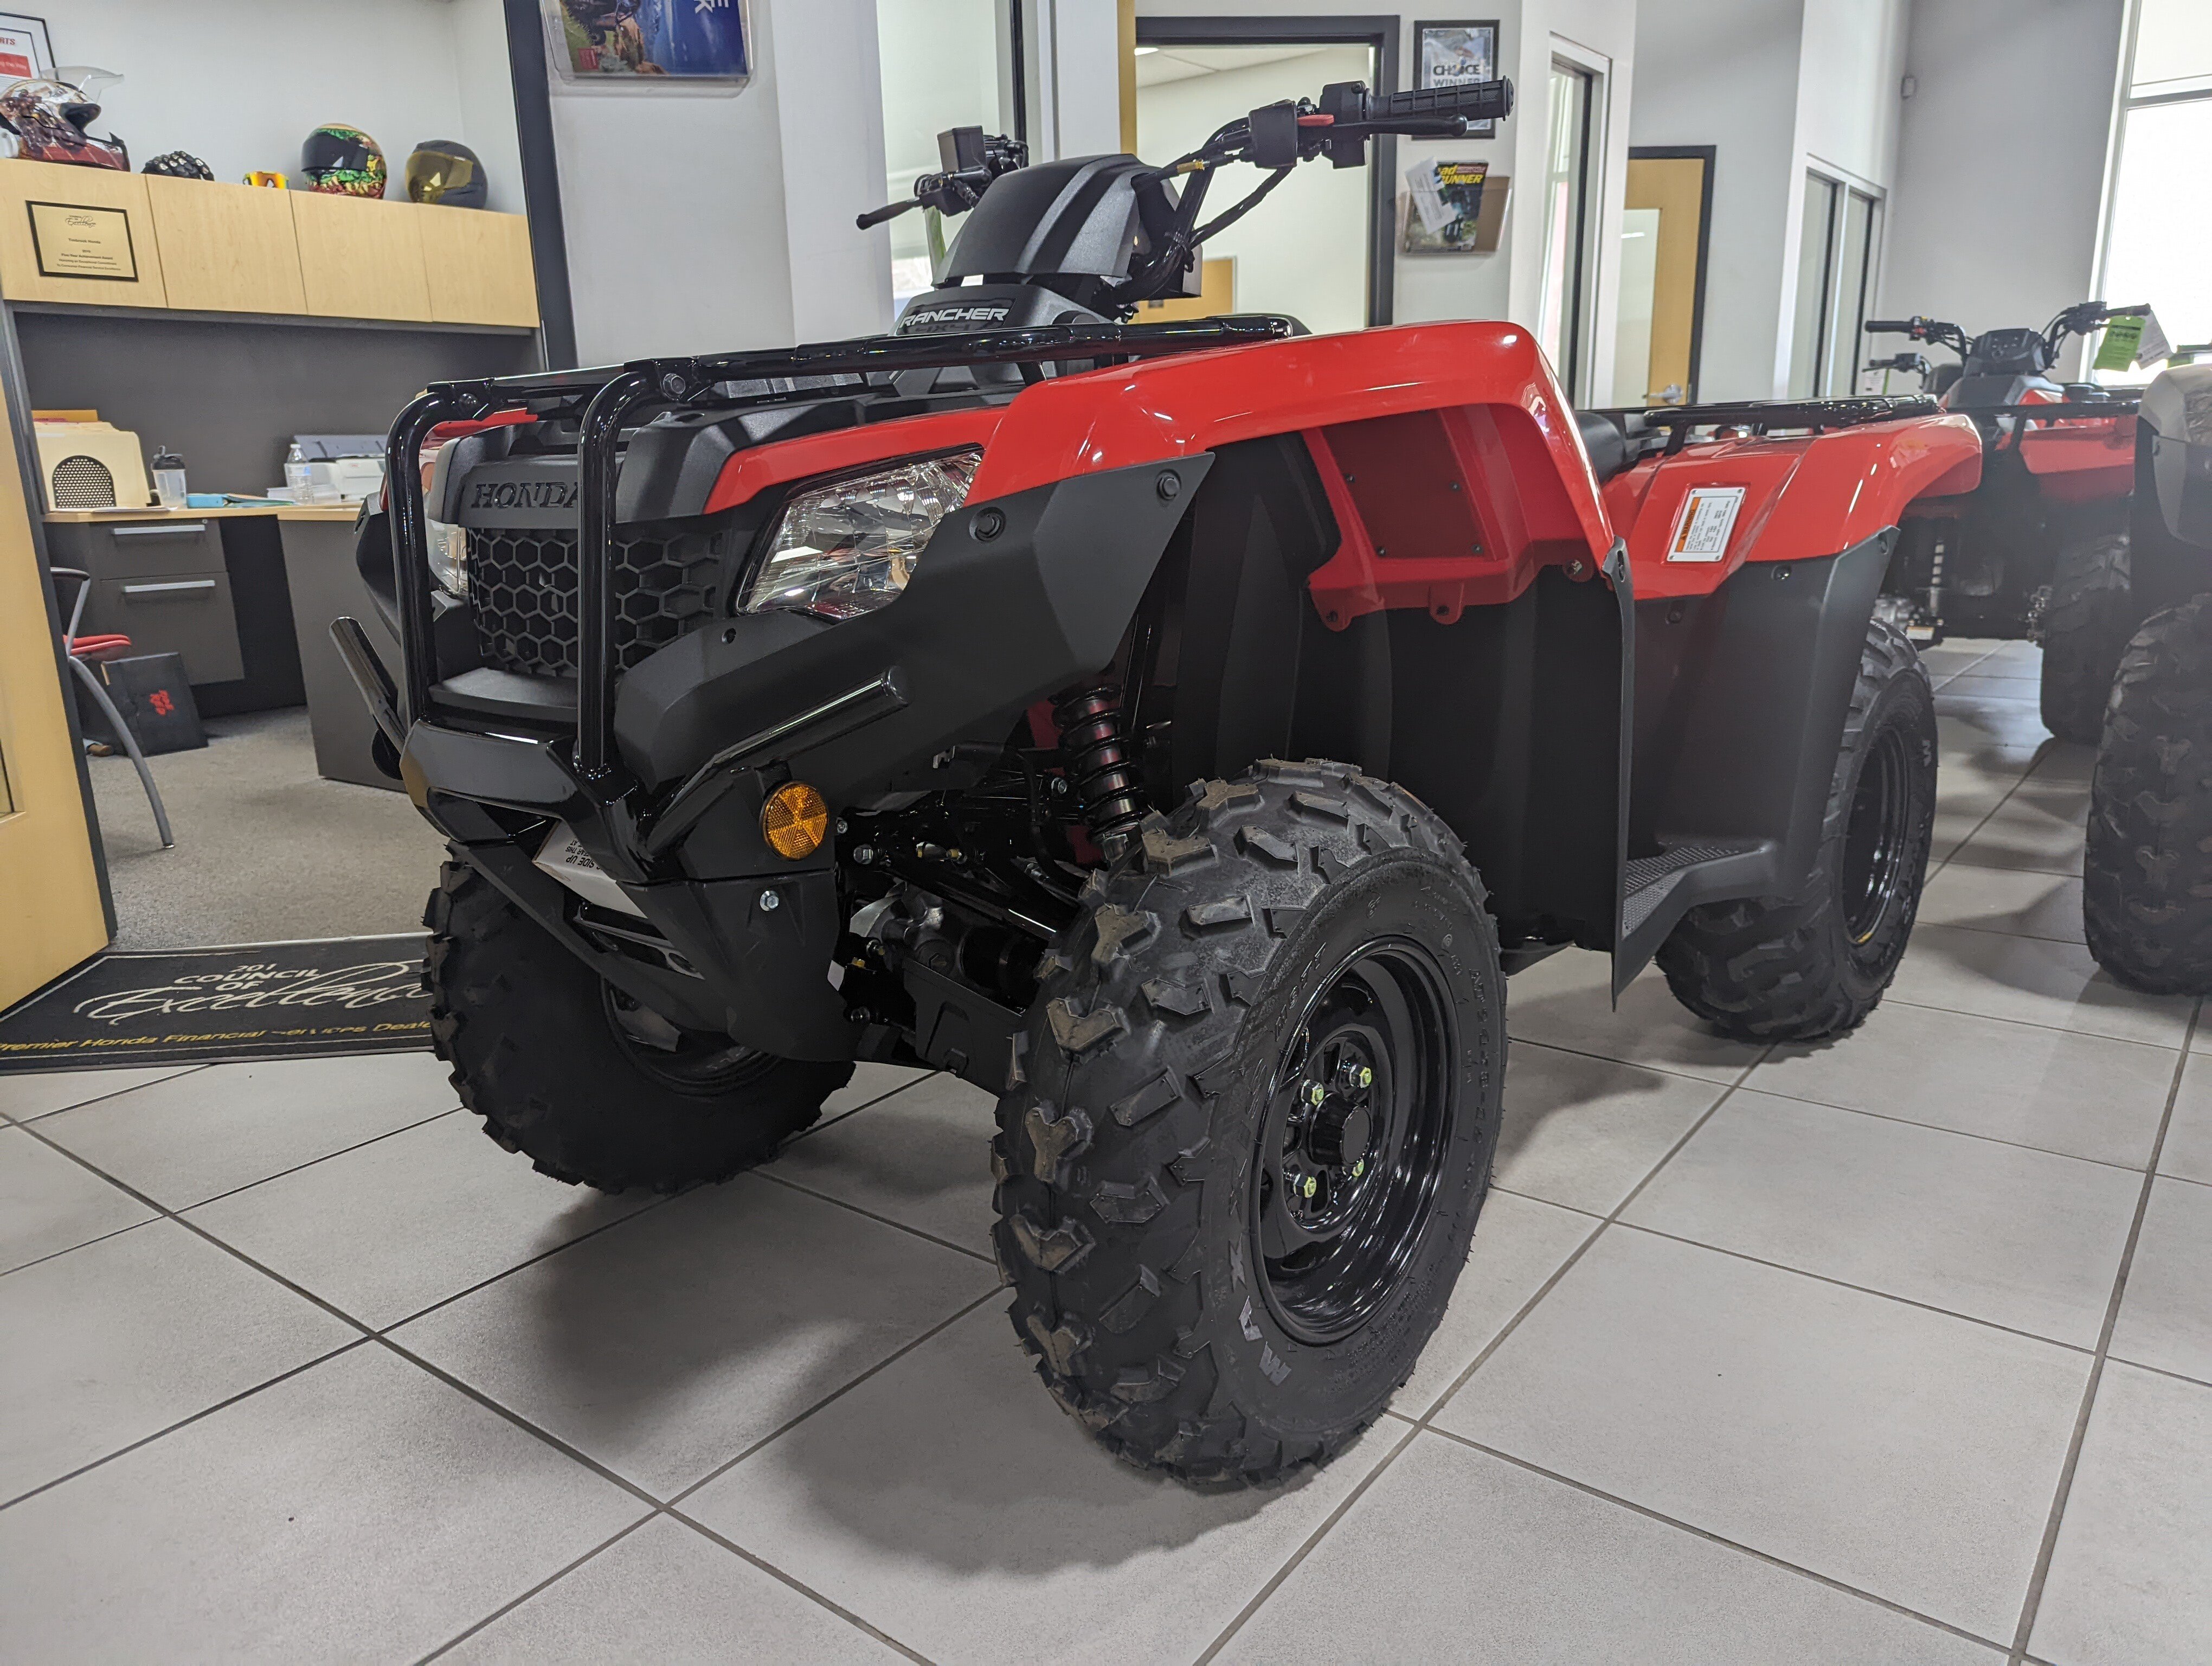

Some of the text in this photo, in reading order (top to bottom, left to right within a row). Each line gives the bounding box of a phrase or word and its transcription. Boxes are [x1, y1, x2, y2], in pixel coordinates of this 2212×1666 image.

[1438, 164, 1458, 176] ad
[899, 307, 1009, 329] RANCHER
[565, 856, 578, 865] UP
[577, 857, 595, 868] SIDE
[174, 969, 320, 984] COUNCIL
[215, 981, 265, 991] OF
[79, 1036, 159, 1048] Honda
[163, 1030, 268, 1043] Financial
[372, 1020, 432, 1032] Deale
